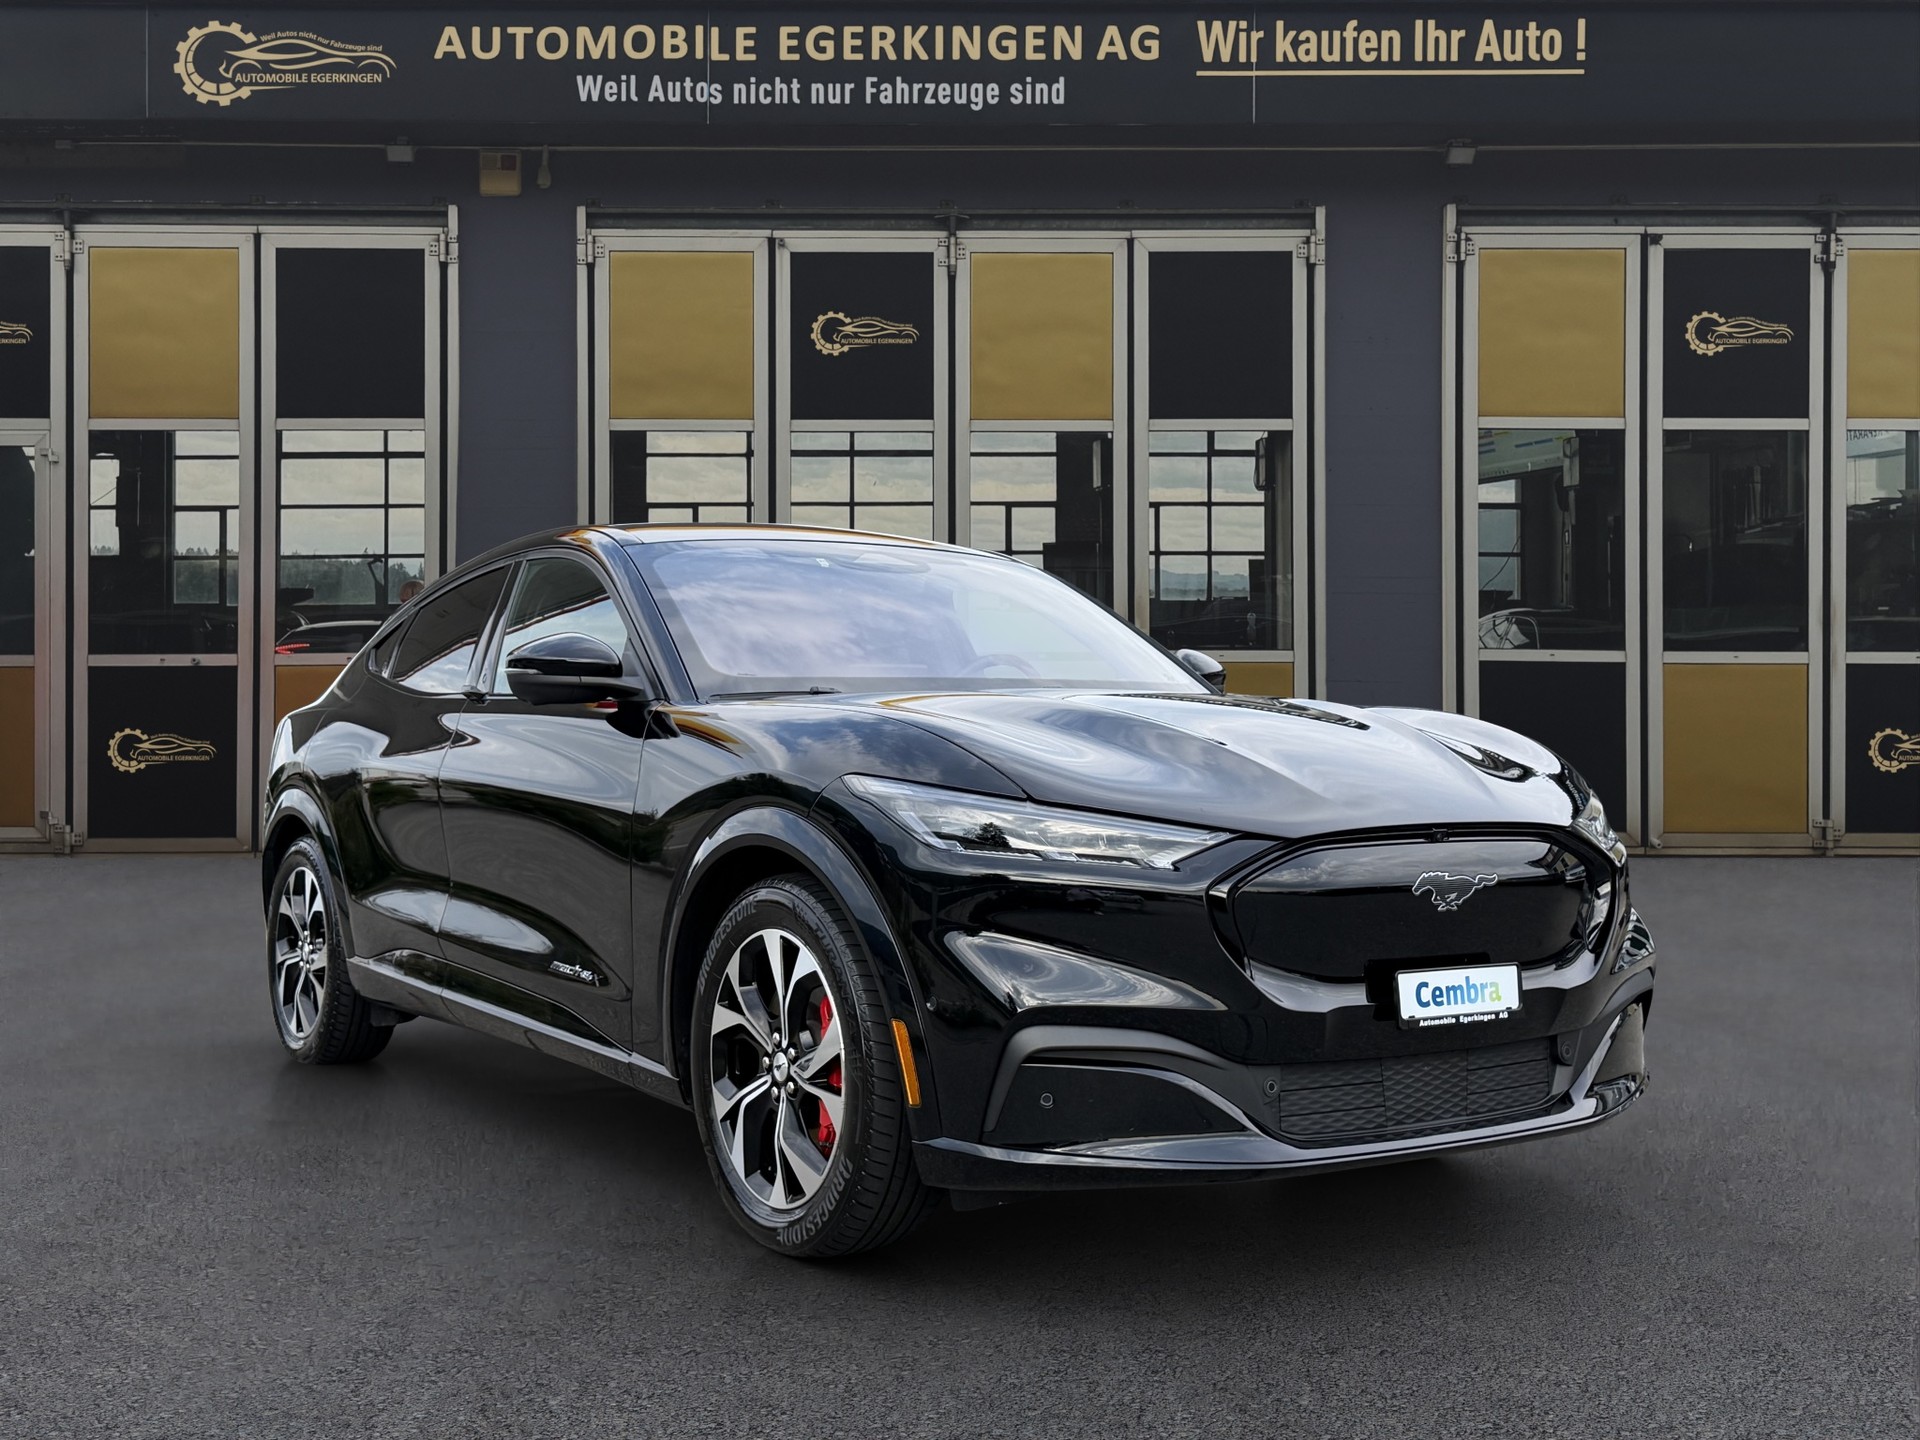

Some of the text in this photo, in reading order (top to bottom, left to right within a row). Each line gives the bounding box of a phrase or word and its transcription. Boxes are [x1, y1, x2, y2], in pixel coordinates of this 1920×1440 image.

[260, 32, 276, 42] Weil
[299, 31, 317, 40] nicht
[317, 36, 331, 45] nur
[330, 40, 366, 51] Fahrzeuge
[434, 25, 1160, 61] AUTOMOBILE EGERKINGEN AG
[1197, 20, 1264, 62] Wir
[1275, 20, 1401, 62] kaufen
[1414, 19, 1466, 61] Ihr
[1474, 19, 1563, 61] Auto
[235, 73, 382, 83] AUTOMOBILE EGERKINGEN
[576, 75, 1065, 111] Weil Autos nicht nur Fahrzeuge sind
[698, 895, 759, 996] BRIDGESTONE
[1415, 975, 1502, 1009] Cembra
[1419, 1011, 1509, 1027] Automobile Egerkingen AG
[776, 1152, 854, 1247] BRIDGESTONE
